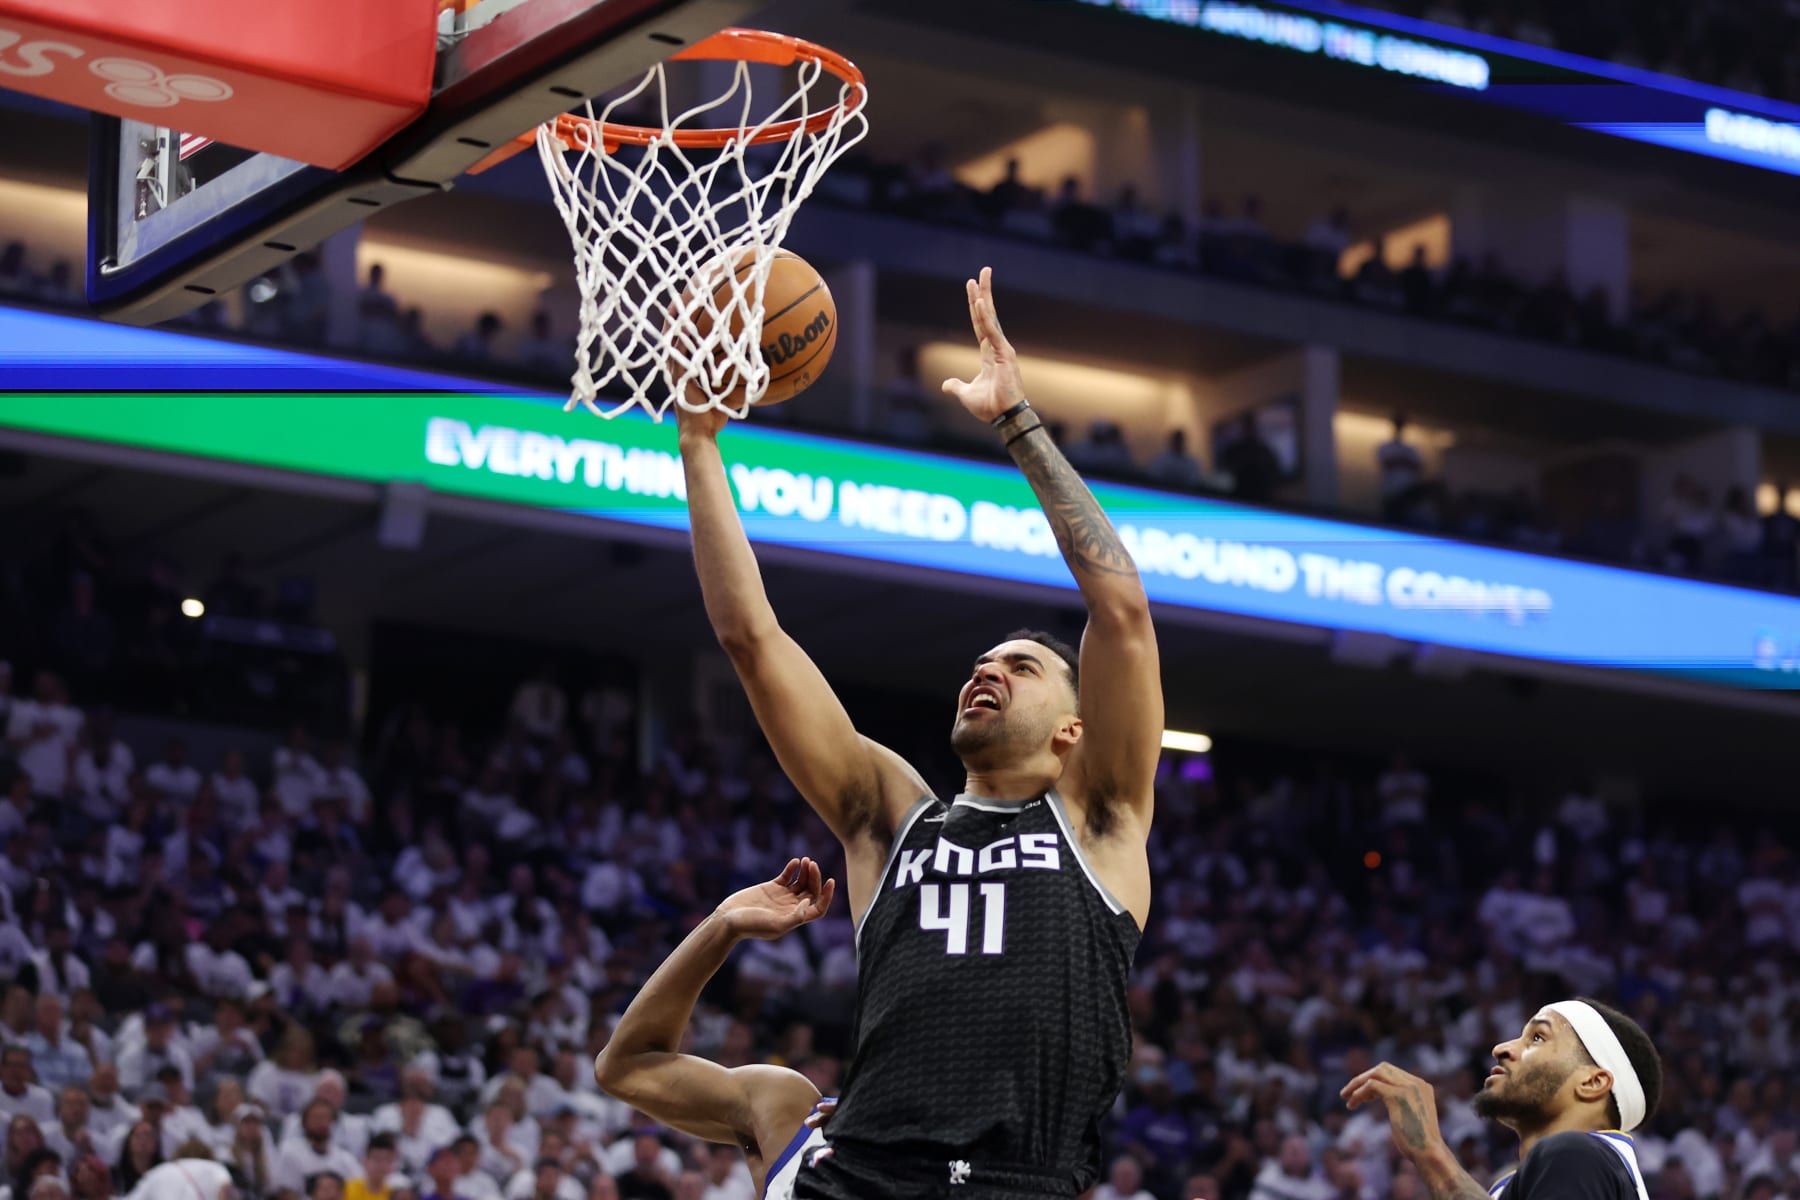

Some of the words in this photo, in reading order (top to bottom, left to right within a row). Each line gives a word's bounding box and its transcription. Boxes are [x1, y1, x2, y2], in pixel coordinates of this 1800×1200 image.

[425, 416, 691, 503] EVERYTHIN
[730, 462, 835, 522] YOU
[838, 480, 968, 543] NEED
[969, 500, 1062, 559] RIG
[1118, 523, 1299, 593] AROUND
[1299, 552, 1386, 606] THE
[894, 832, 1060, 889] KNGS
[918, 881, 1006, 955] 41
